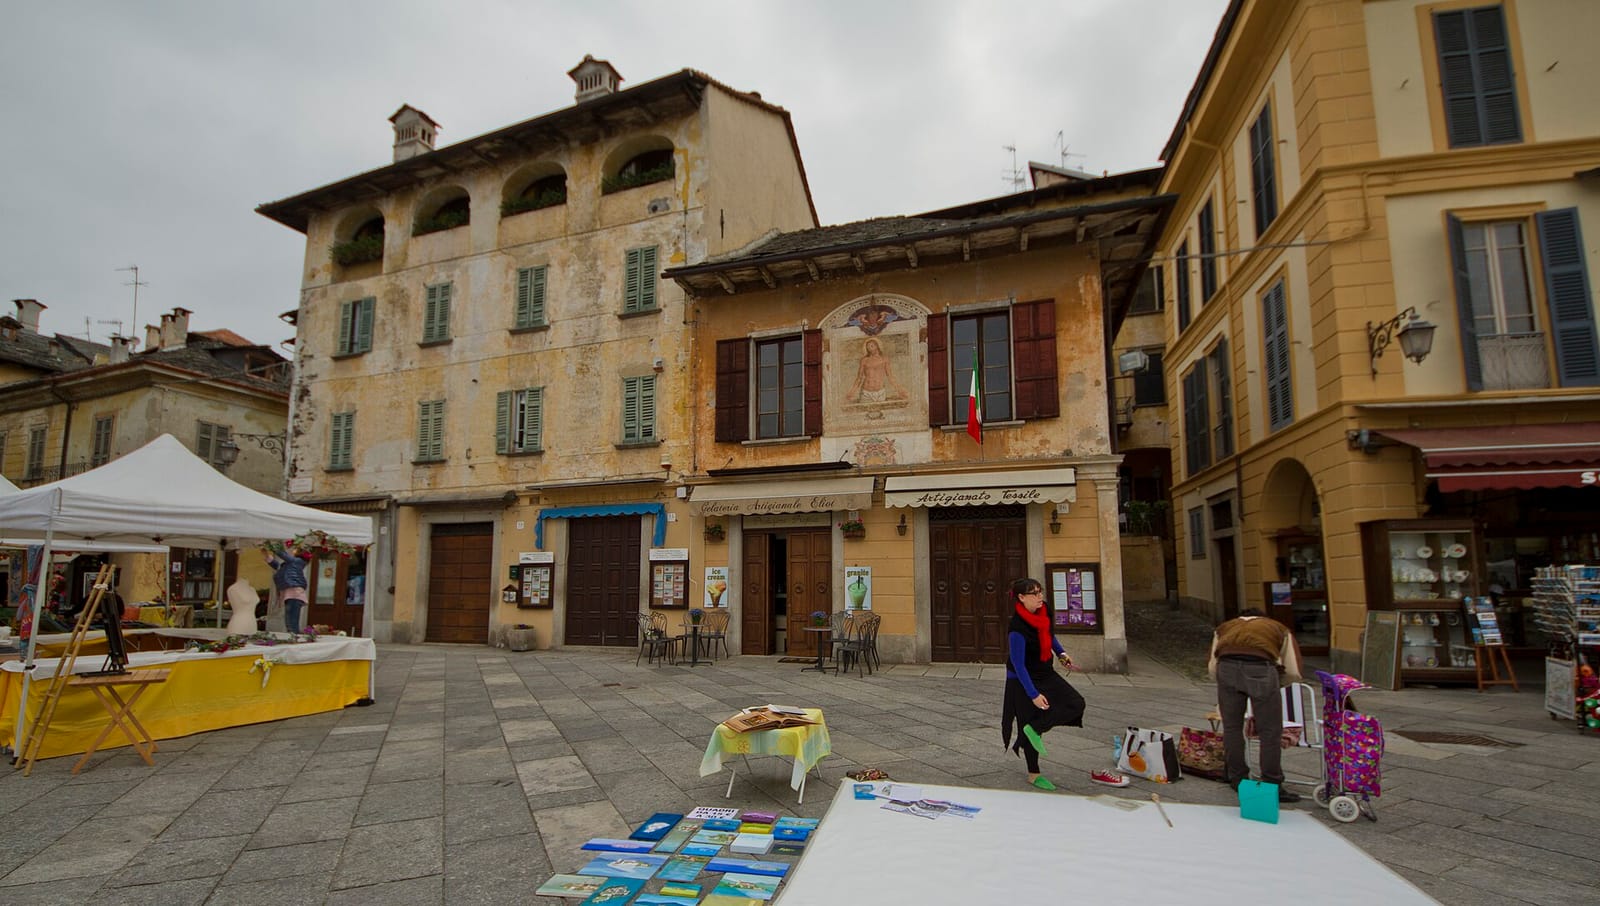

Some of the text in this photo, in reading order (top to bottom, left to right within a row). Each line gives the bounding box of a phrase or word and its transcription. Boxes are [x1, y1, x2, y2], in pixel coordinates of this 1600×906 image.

[1581, 471, 1600, 484] S
[918, 488, 1041, 504] Artigianato Tessile
[701, 502, 739, 514] Gelateria
[748, 499, 801, 512] Artigianale
